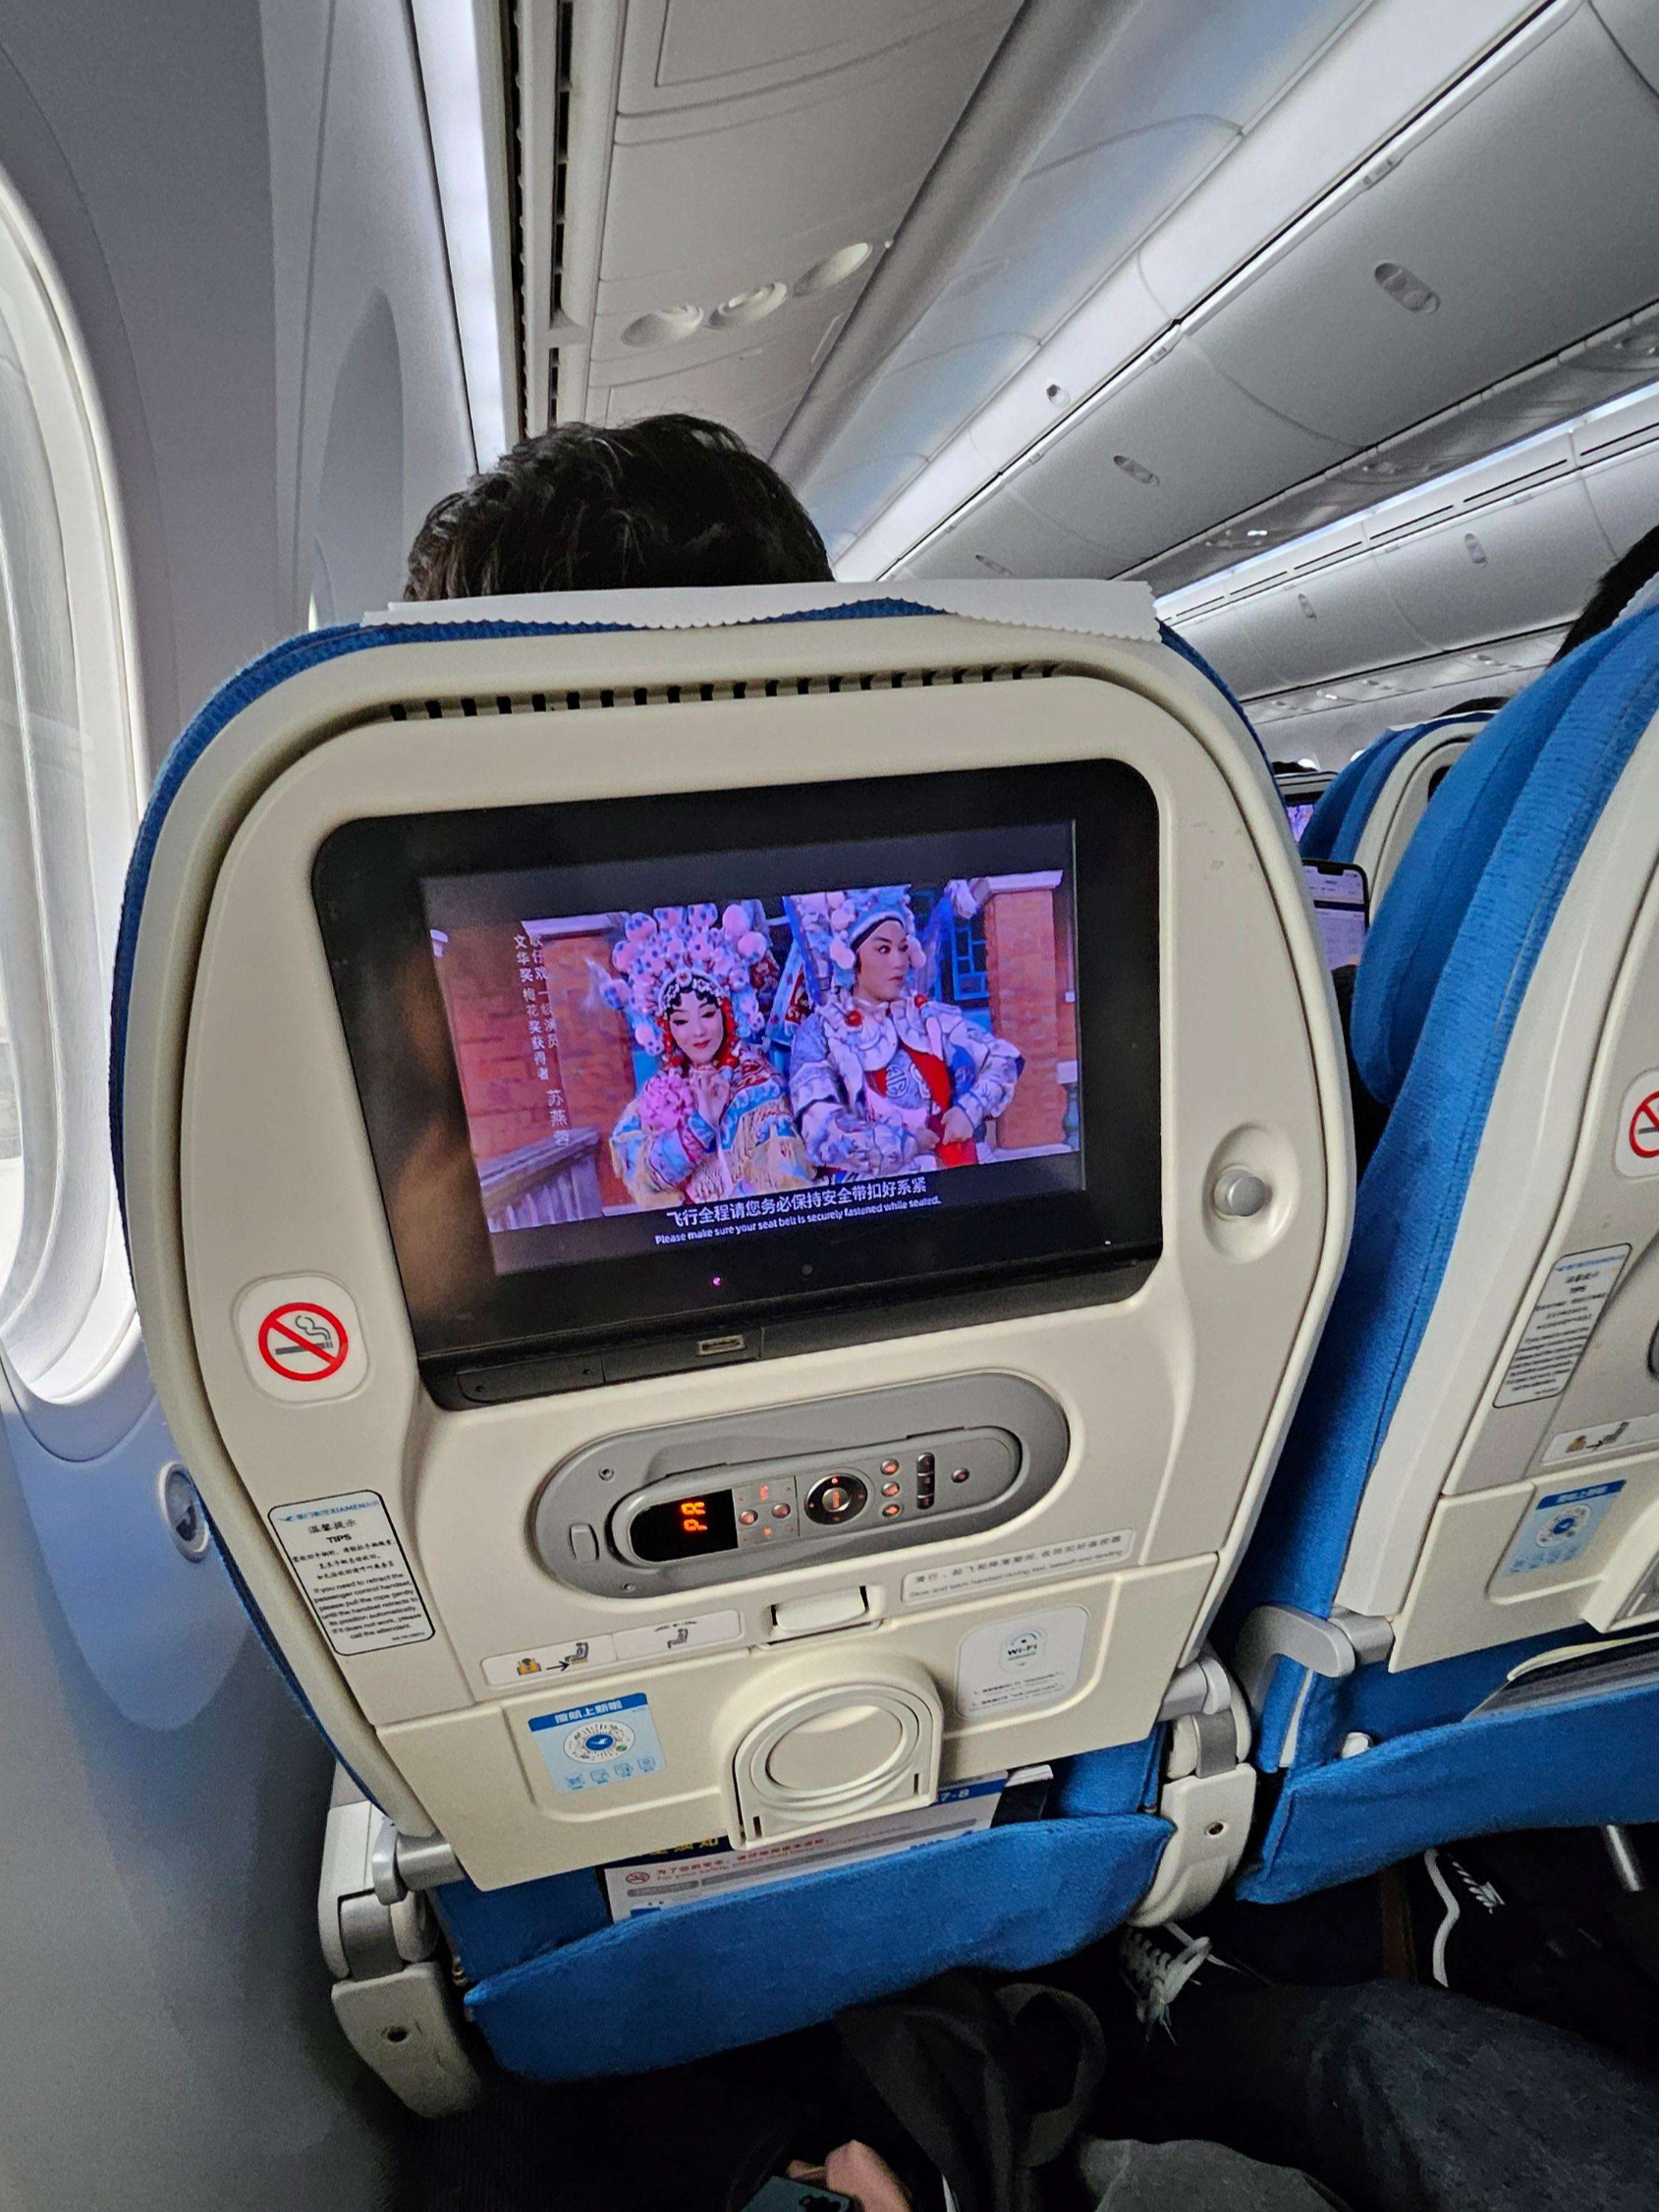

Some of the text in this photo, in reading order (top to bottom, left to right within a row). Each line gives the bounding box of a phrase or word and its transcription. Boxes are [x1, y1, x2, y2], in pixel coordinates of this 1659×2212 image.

[654, 1195, 942, 1244] Please make sure your seat belt is securely fastened while seated.
[666, 1176, 928, 1228] 飞行全程请您务必保持安全带扣好系紧
[326, 1533, 353, 1544] TIPS
[554, 1699, 624, 1724] 厦航上新啦
